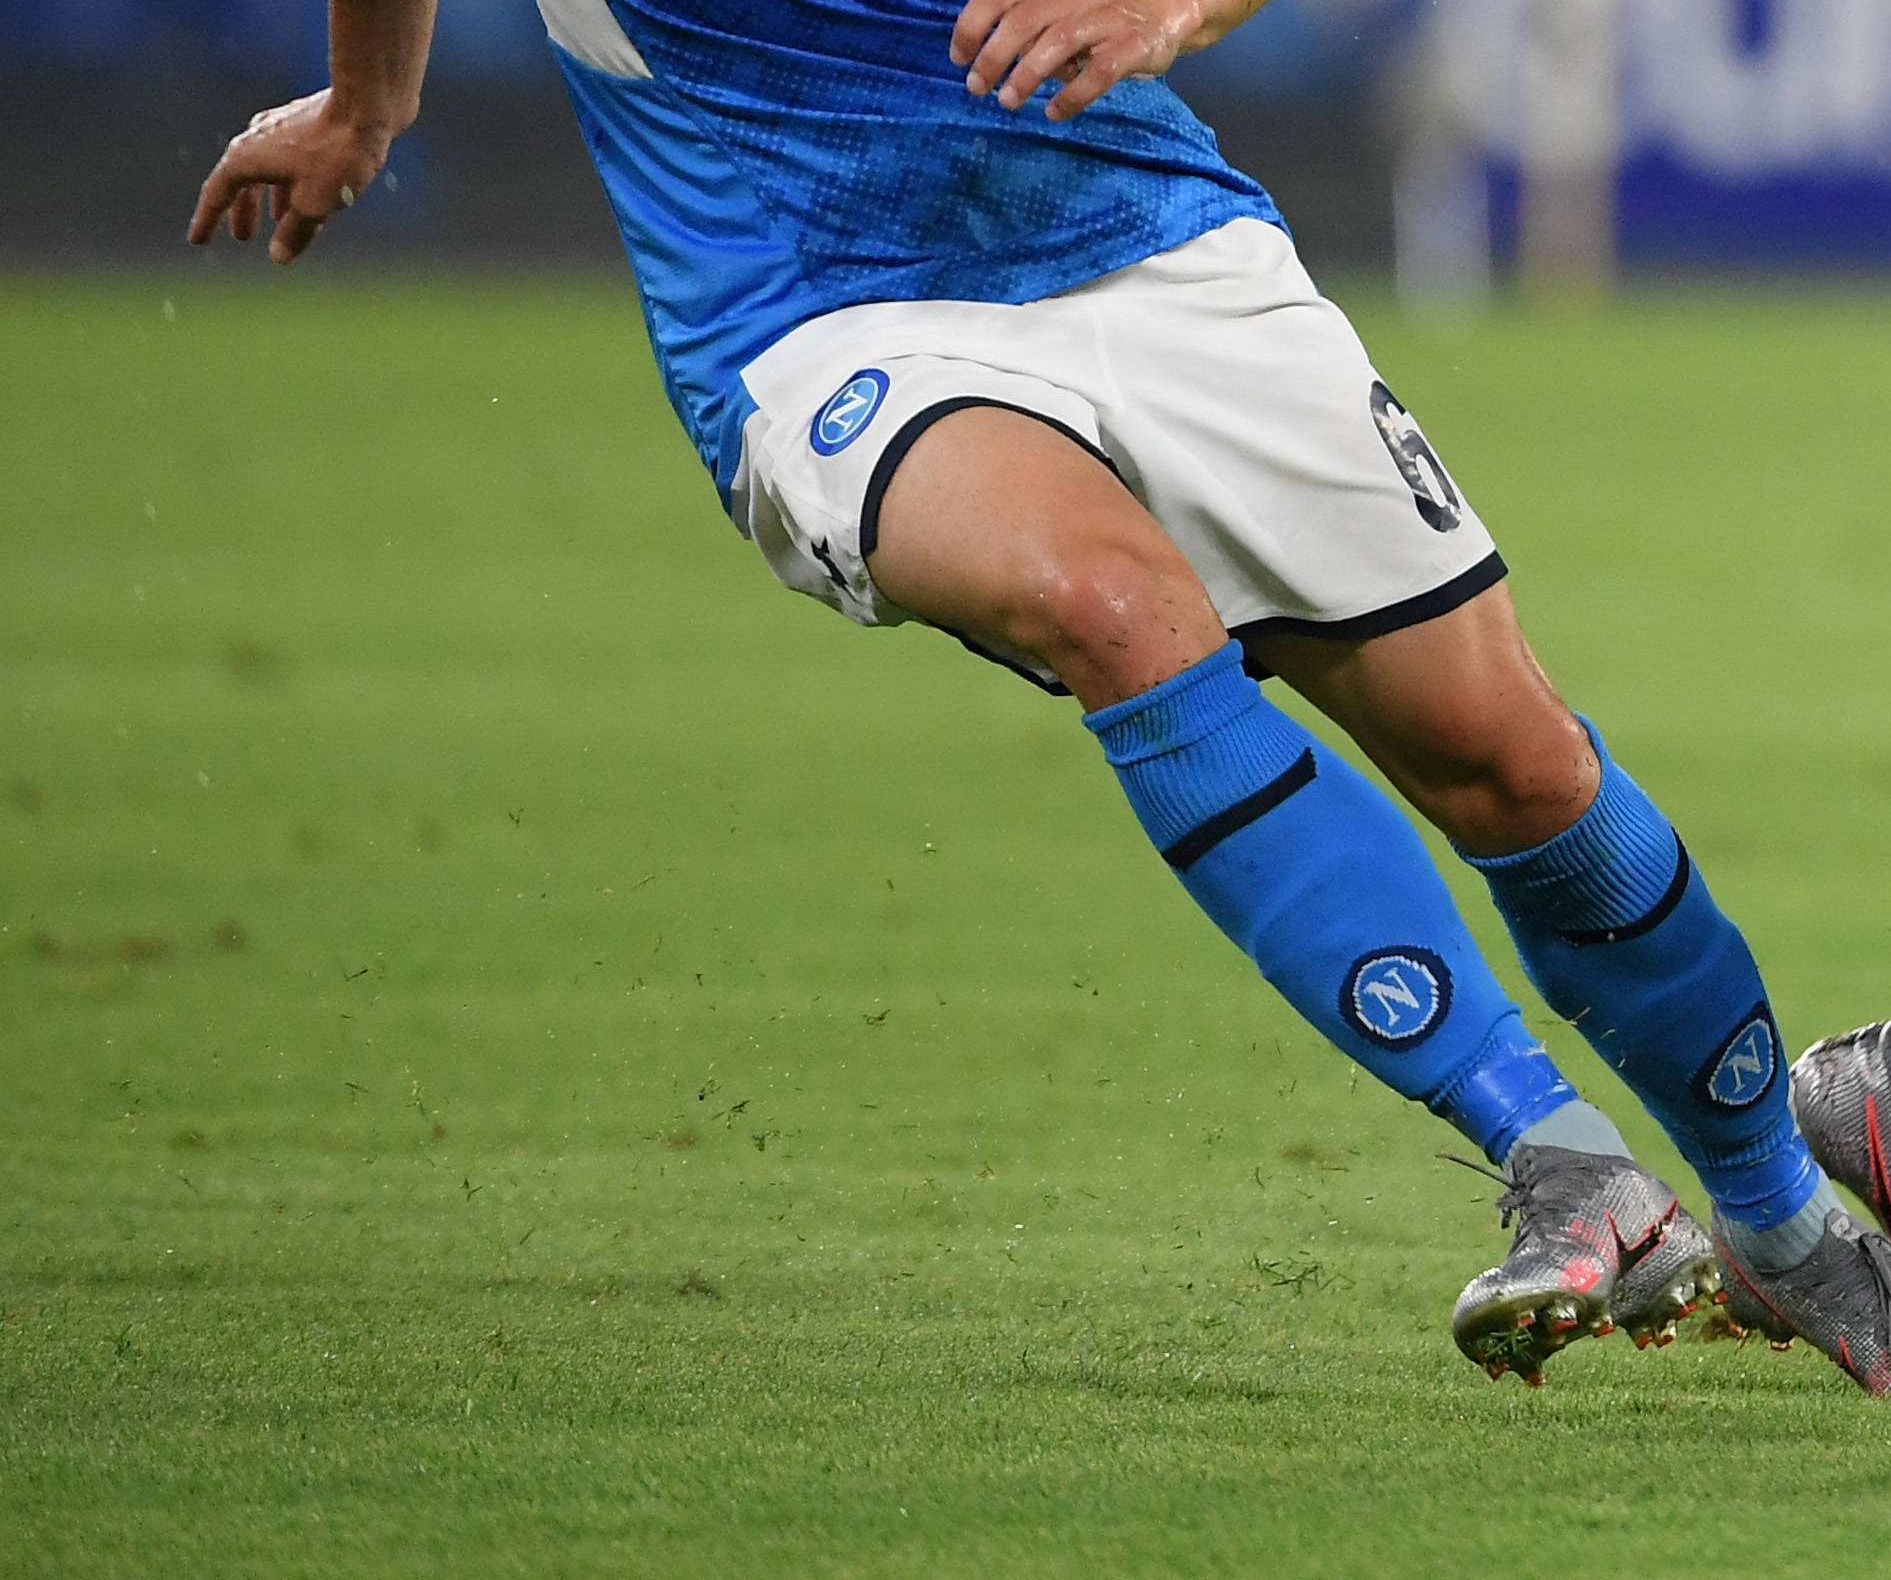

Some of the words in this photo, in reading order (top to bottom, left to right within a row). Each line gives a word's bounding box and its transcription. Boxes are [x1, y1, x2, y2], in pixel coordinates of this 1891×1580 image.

[825, 387, 868, 432] N
[1369, 380, 1461, 533] 6
[1363, 967, 1420, 1027] N
[1726, 1032, 1762, 1093] N
